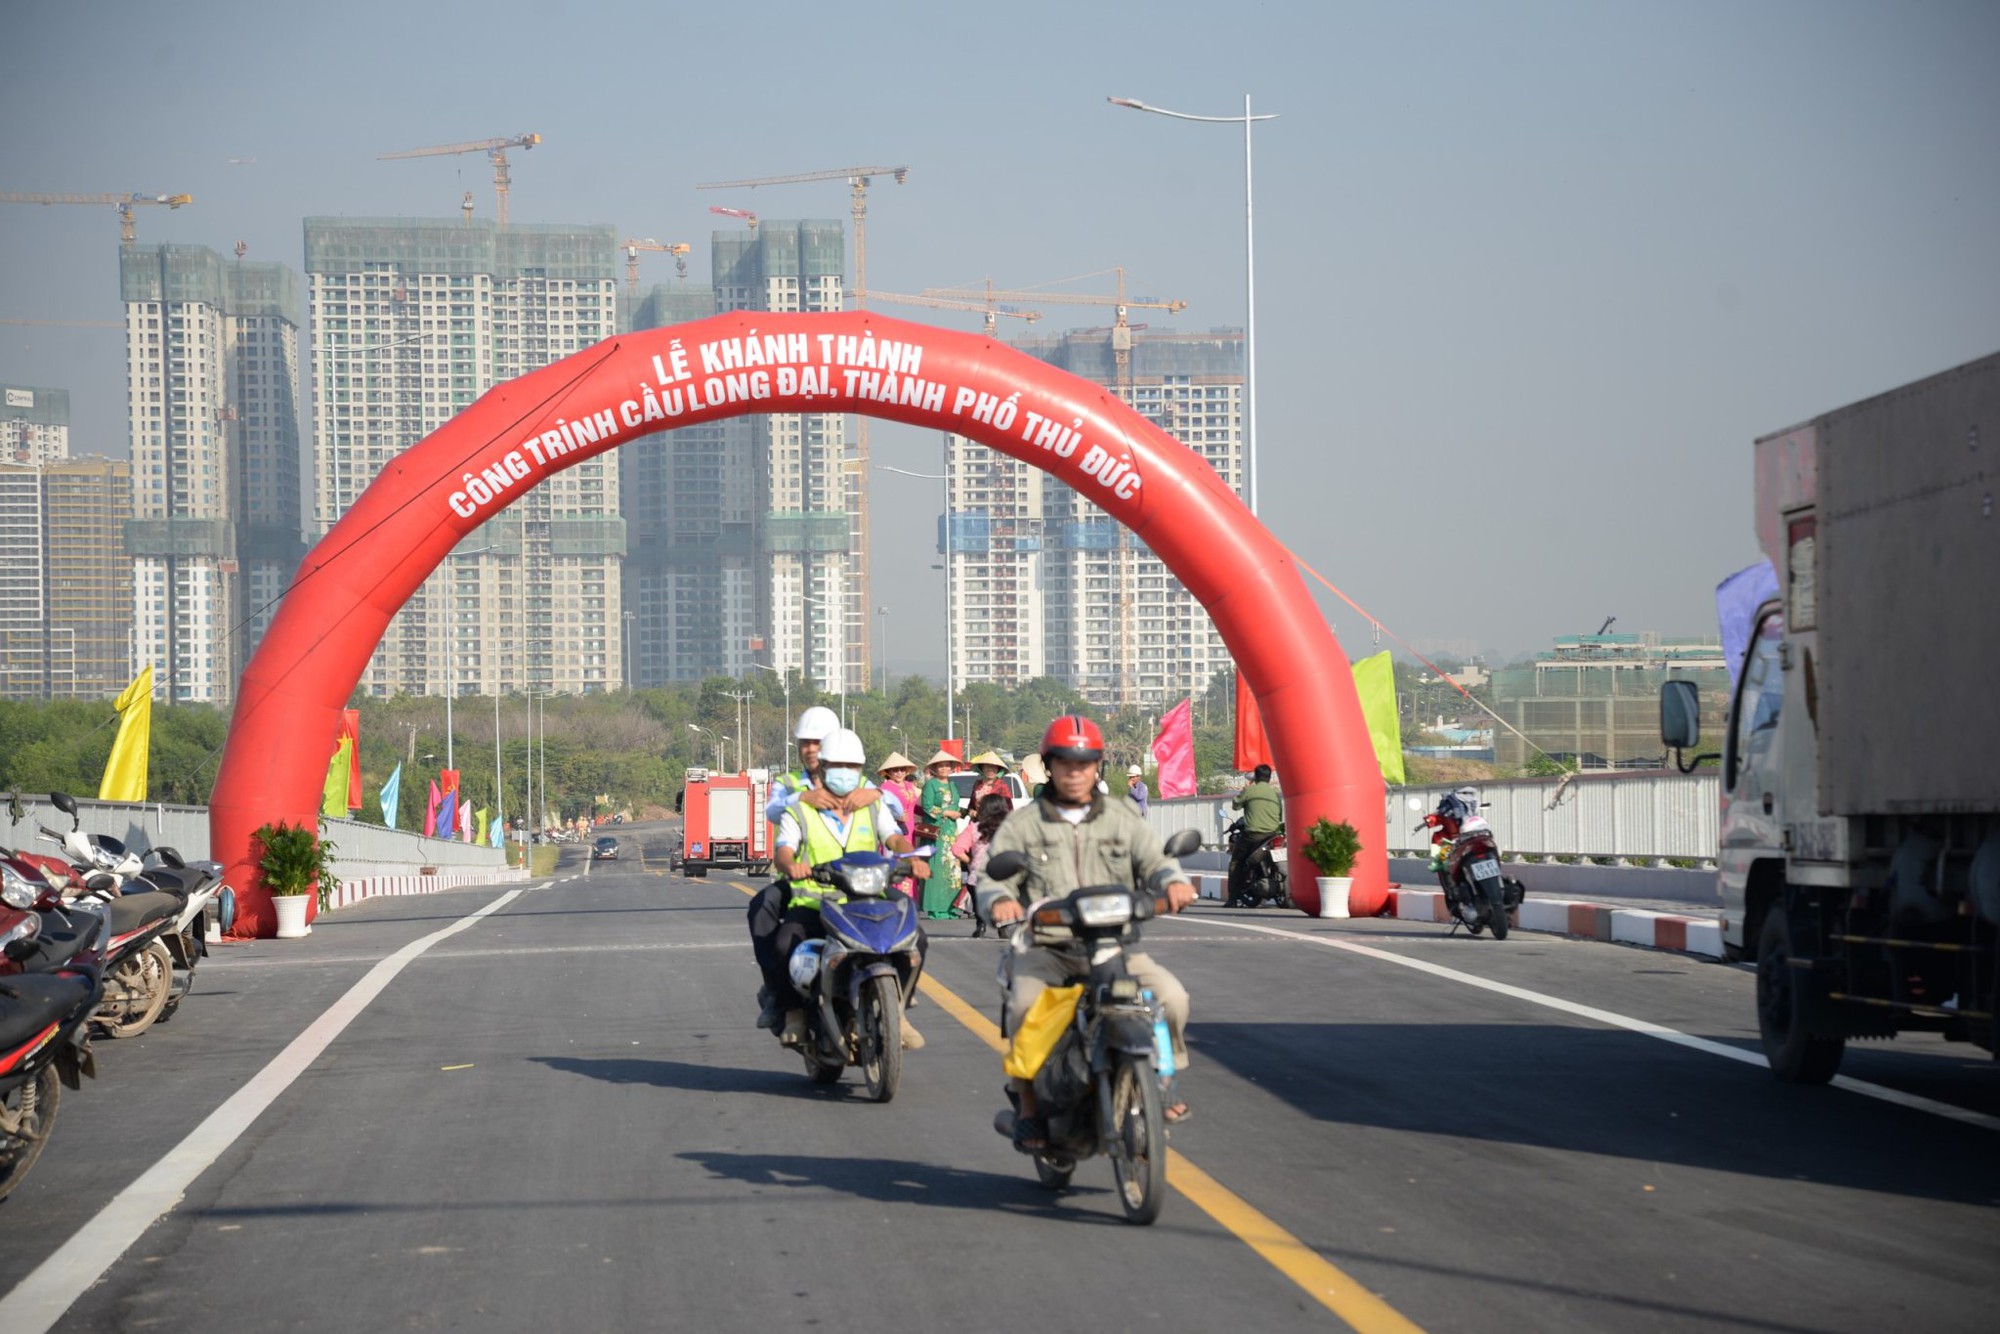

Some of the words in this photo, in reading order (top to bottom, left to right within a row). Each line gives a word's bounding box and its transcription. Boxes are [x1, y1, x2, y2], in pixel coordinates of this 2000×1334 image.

[652, 338, 692, 386] LỄ
[699, 328, 809, 374] KHÁNH
[817, 329, 923, 376] THÀNH
[448, 451, 531, 518] CÔNG
[523, 408, 619, 466] TRÌNH
[619, 382, 684, 428] CẦU
[687, 371, 771, 411] LONG
[776, 366, 838, 399] ĐẠI,
[843, 368, 946, 412] THÀNH
[952, 391, 1022, 431] PHỐ
[1021, 418, 1083, 458] THỦ
[1079, 444, 1142, 500] ĐỨC
